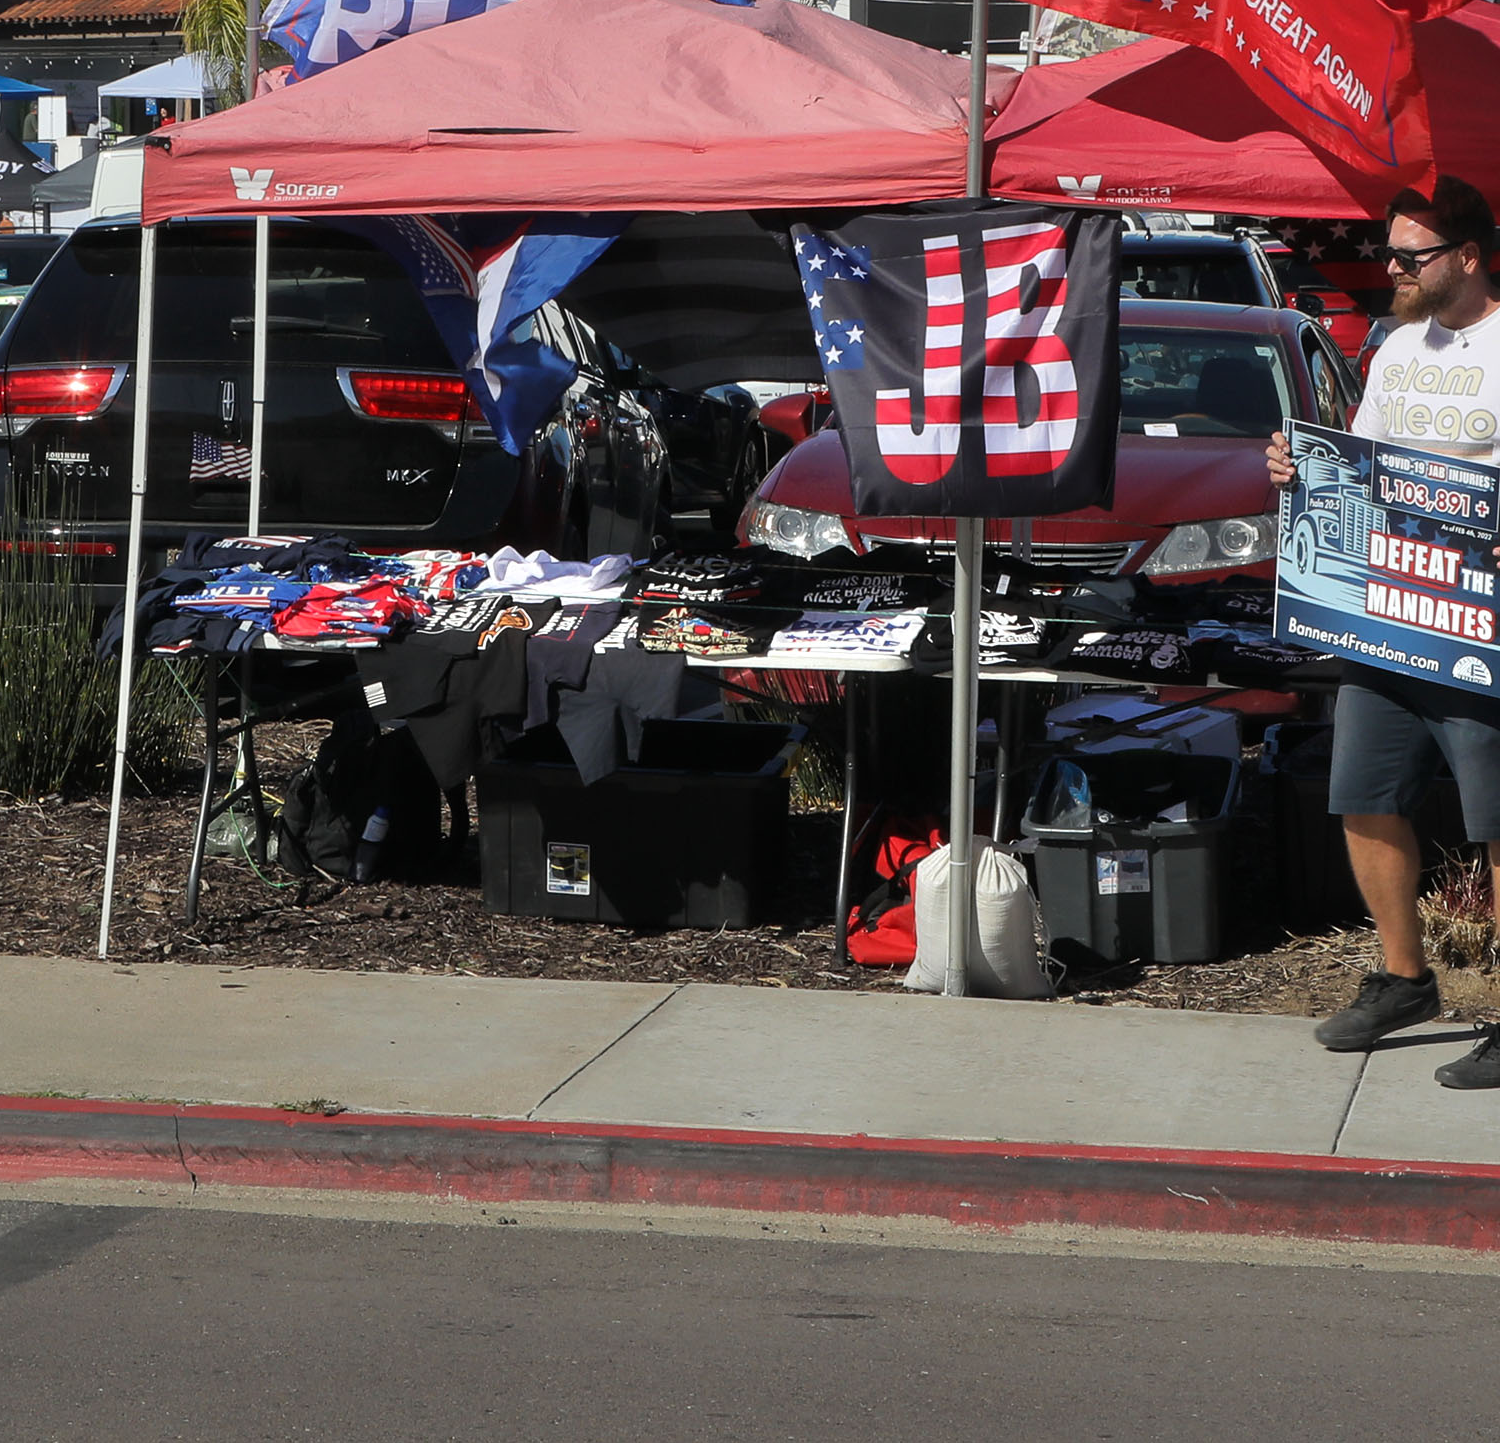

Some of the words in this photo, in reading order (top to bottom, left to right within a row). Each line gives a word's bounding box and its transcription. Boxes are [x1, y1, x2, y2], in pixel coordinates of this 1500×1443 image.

[1313, 41, 1374, 123] AGAIN!
[274, 183, 338, 197] sorara
[1382, 356, 1485, 396] slam
[1380, 393, 1498, 442] diego
[386, 468, 434, 485] MKX
[1381, 453, 1426, 475] COVID-19
[1427, 462, 1447, 480] JAB
[1448, 467, 1491, 489] INJURIES
[1309, 497, 1325, 509] Psalm
[1379, 474, 1471, 519] 1,103,891
[1477, 531, 1493, 541] 2022
[1369, 531, 1461, 585] DEFEAT
[1461, 567, 1495, 596] THE
[1366, 581, 1494, 642] MANDATES
[1288, 616, 1440, 673] Banners4Freedom.com
